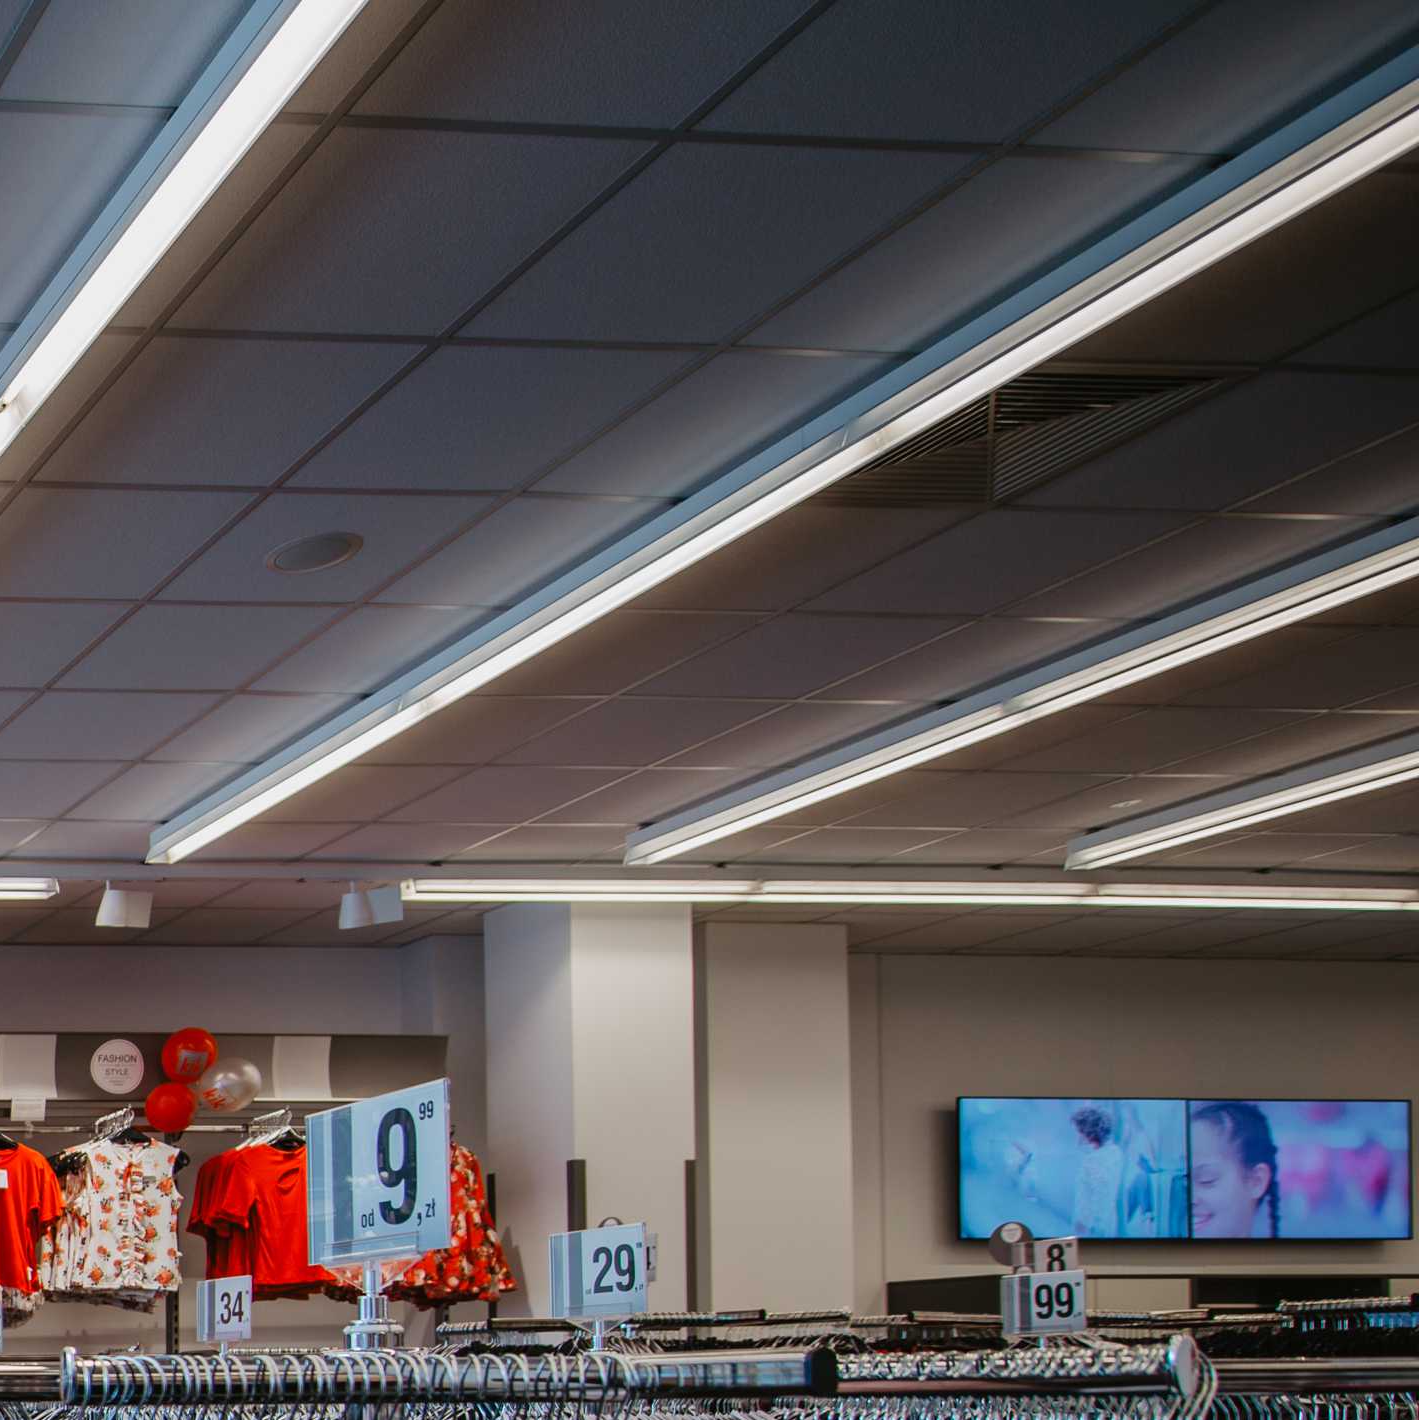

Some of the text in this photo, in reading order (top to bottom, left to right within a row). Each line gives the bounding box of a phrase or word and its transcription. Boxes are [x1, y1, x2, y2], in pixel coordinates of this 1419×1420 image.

[98, 1054, 138, 1064] FASHION
[105, 1068, 129, 1076] STYLE
[361, 1209, 375, 1228] od
[418, 1101, 434, 1120] 99
[220, 1290, 244, 1325] 34
[1034, 1282, 1074, 1320] 99
